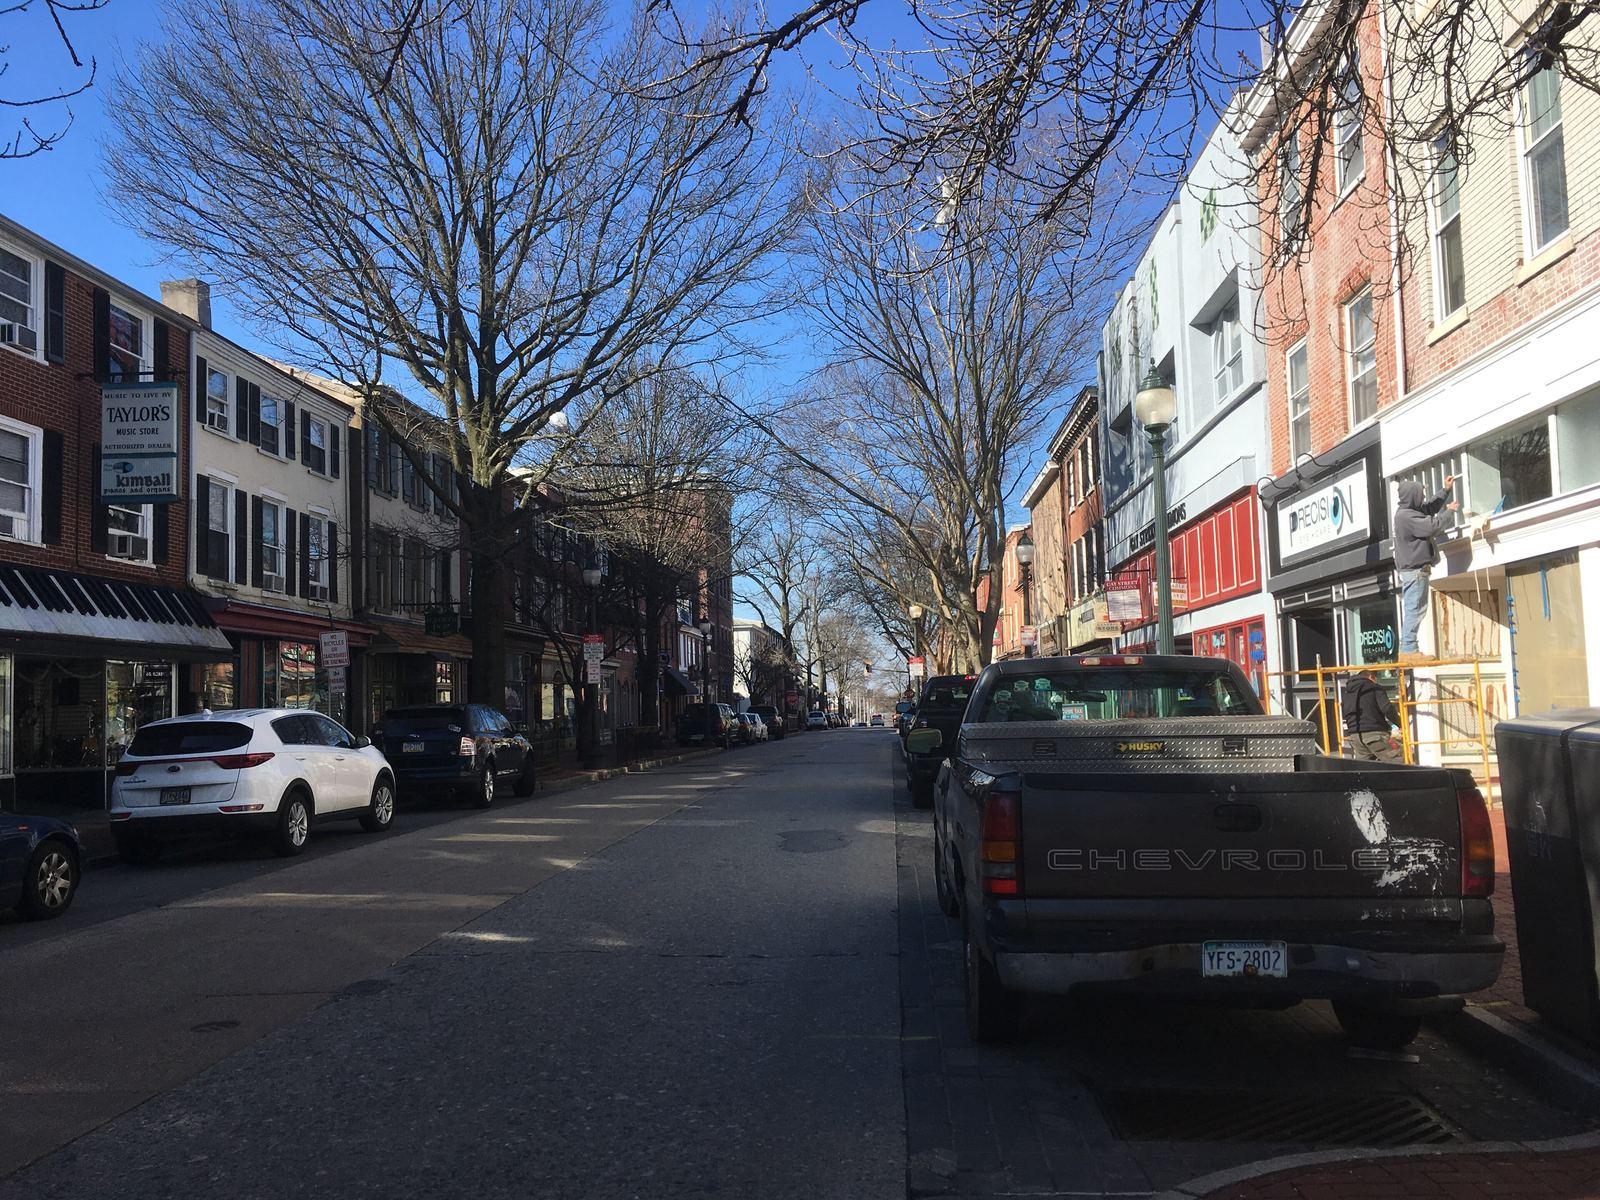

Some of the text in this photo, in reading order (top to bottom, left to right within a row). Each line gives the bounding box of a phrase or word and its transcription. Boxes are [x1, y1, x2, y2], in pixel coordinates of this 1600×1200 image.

[106, 404, 170, 422] TAYLOR'S
[116, 427, 159, 436] MUSIC STORE
[1128, 742, 1164, 751] HUSKY
[1207, 950, 1281, 971] YFS-2802
